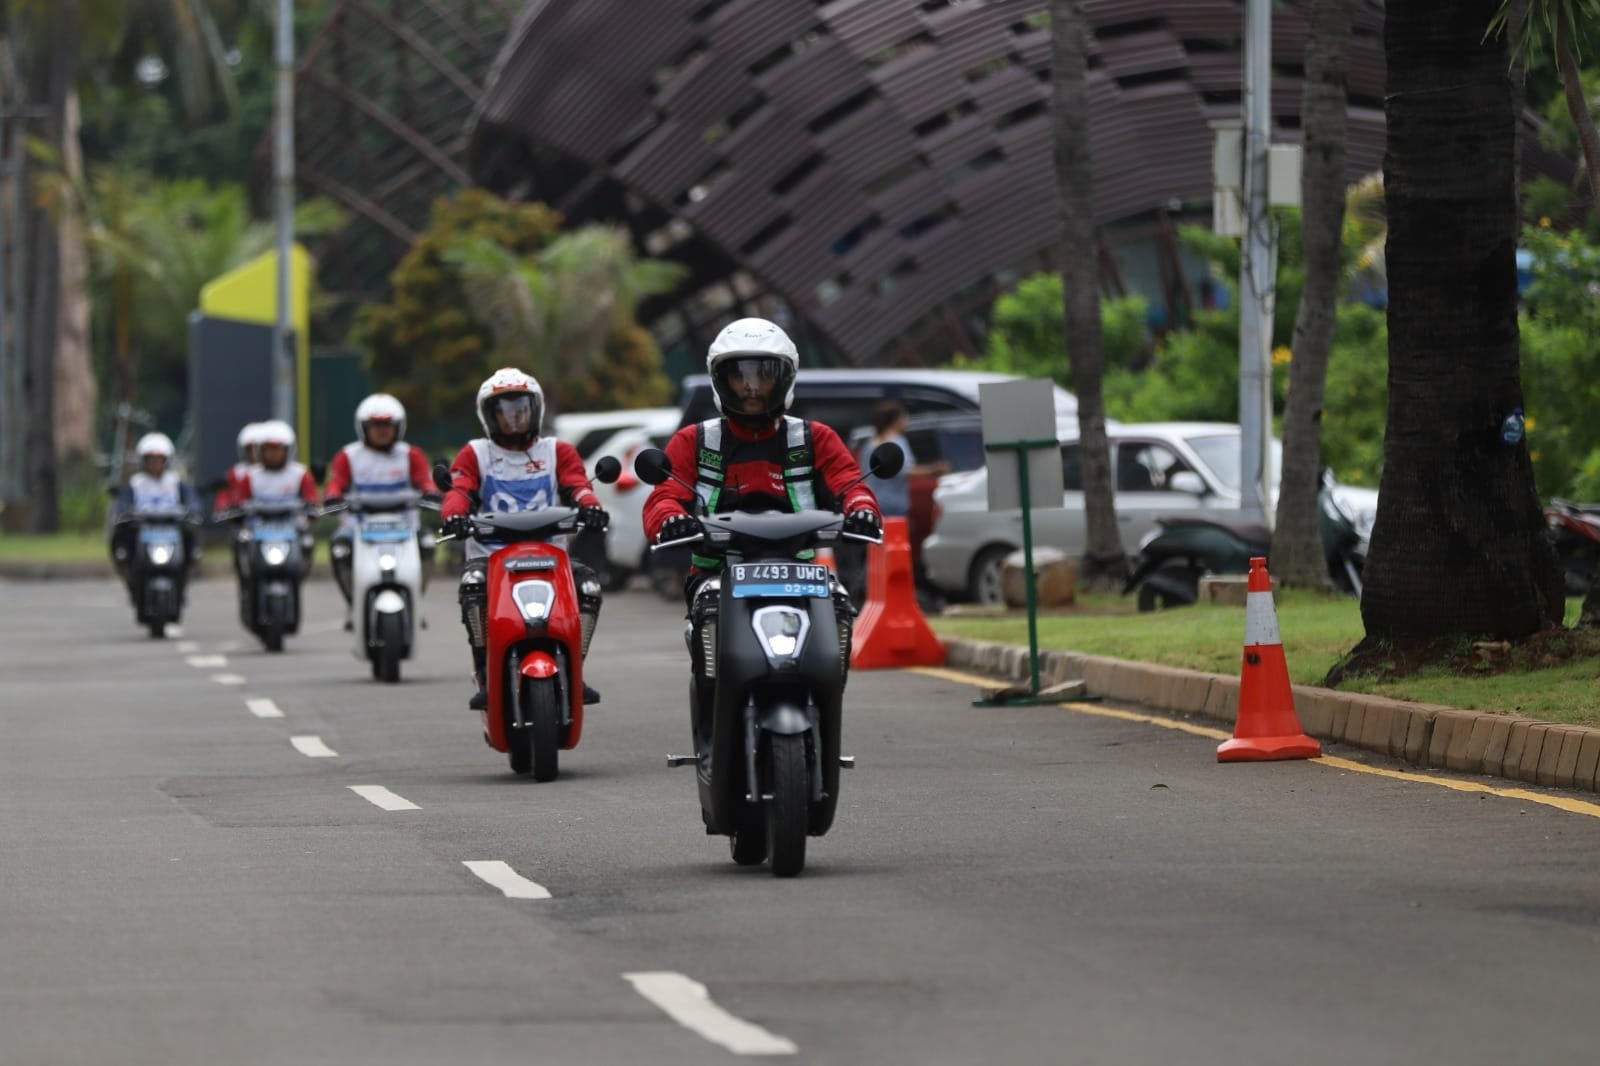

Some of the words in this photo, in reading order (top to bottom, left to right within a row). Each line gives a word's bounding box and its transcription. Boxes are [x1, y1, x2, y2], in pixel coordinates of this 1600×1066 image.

[517, 560, 555, 568] HONDA
[736, 566, 746, 581] B
[752, 566, 789, 580] 4493
[796, 566, 825, 581] UWC
